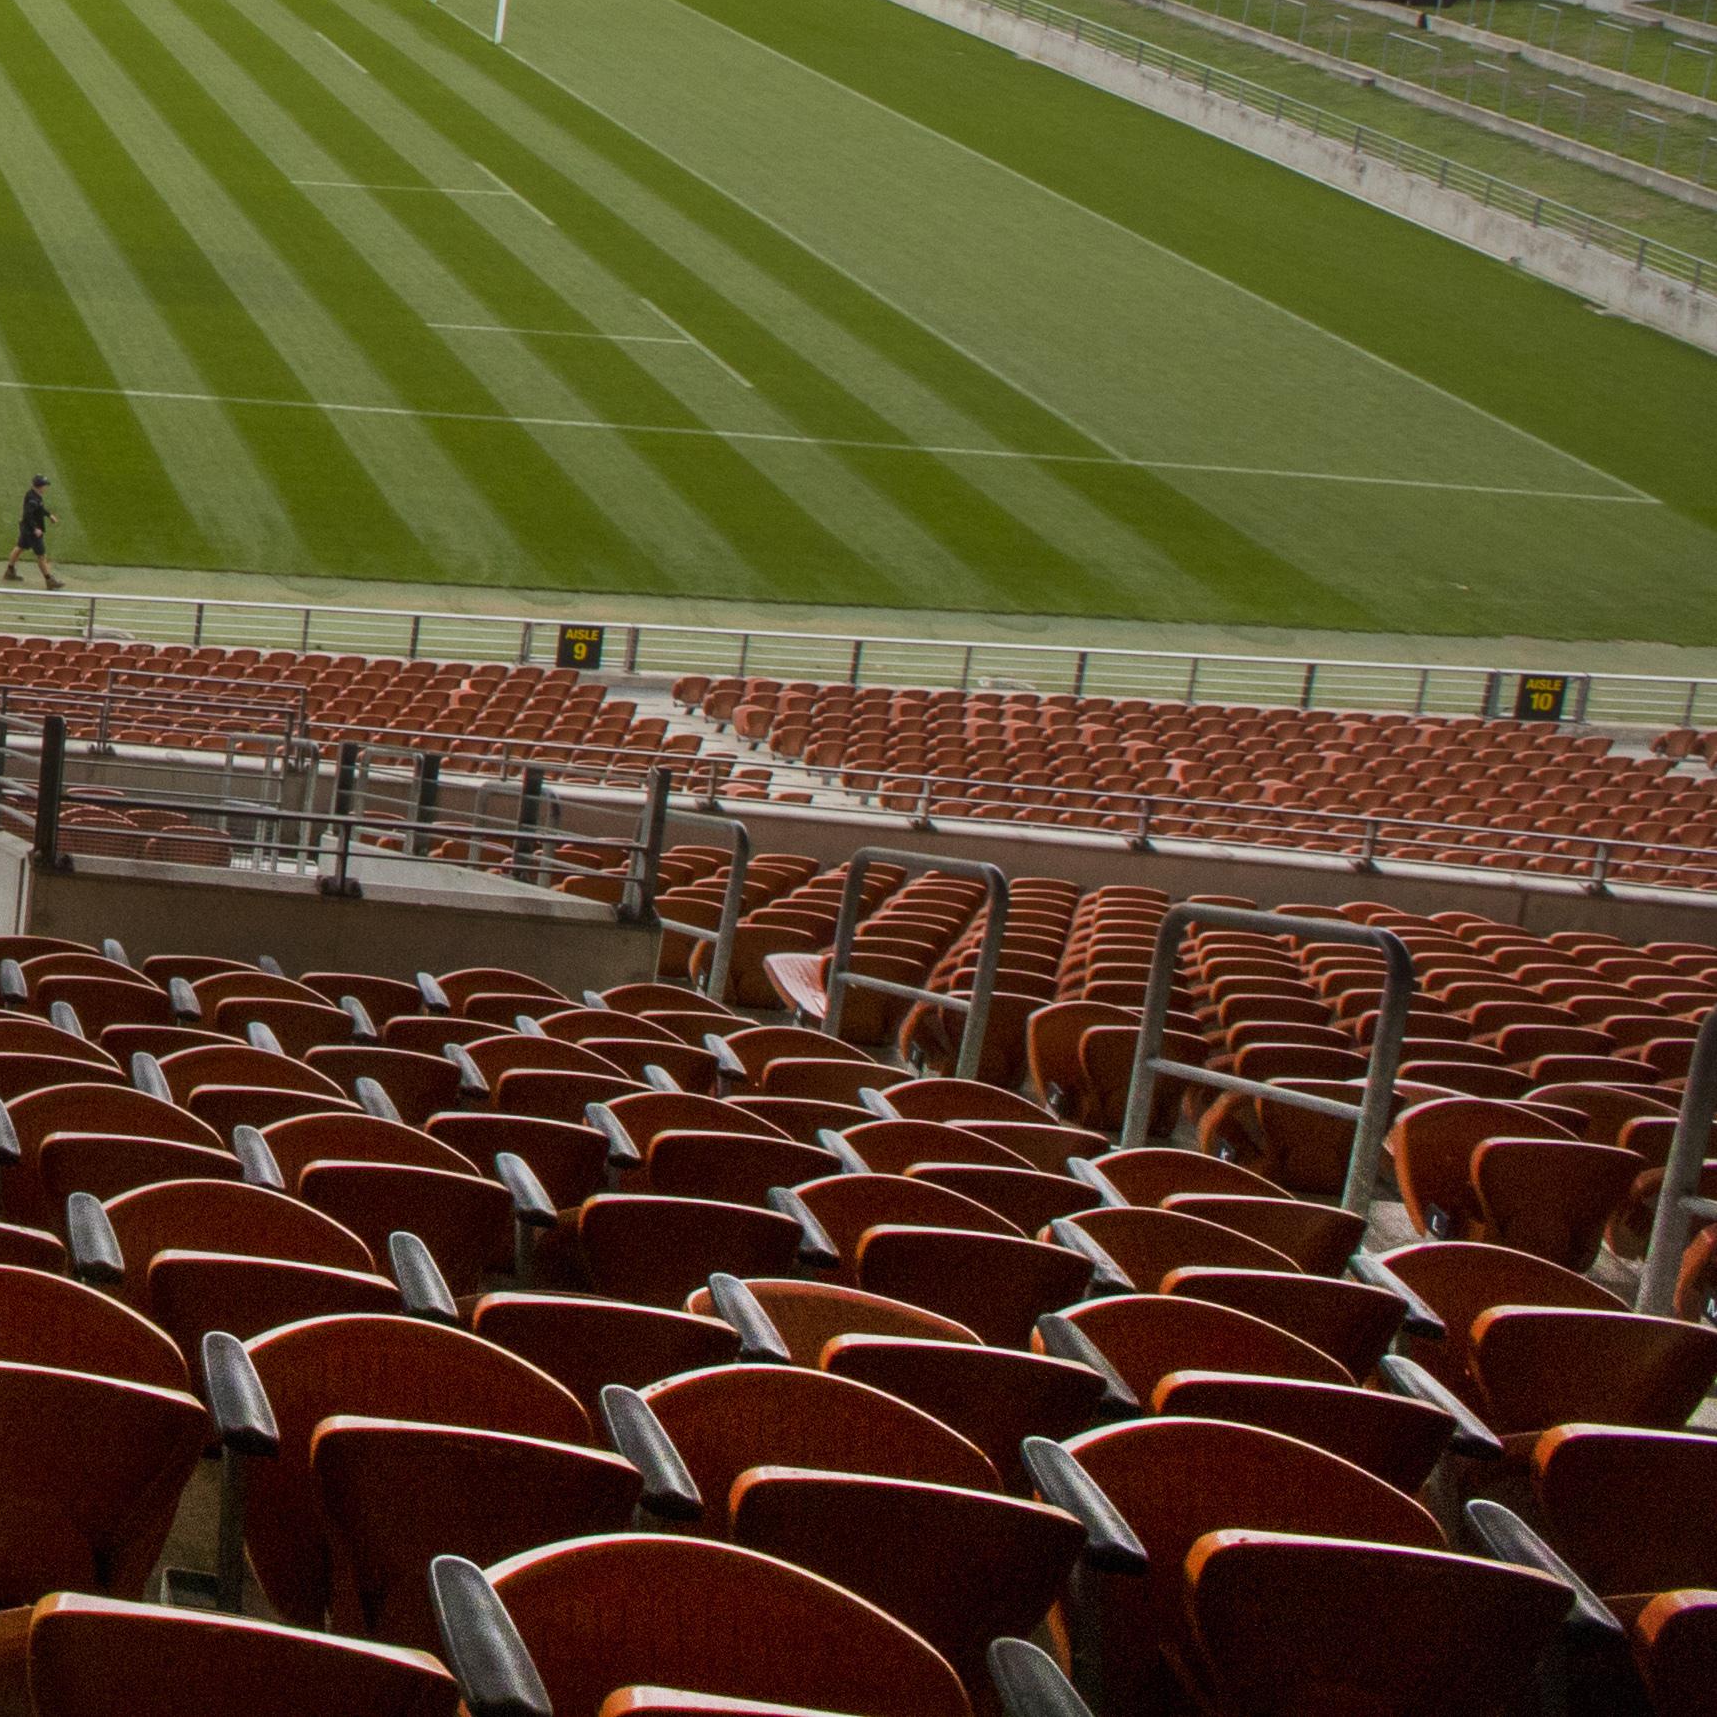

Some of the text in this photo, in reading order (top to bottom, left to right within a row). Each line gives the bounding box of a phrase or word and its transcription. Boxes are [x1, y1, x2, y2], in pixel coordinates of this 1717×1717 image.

[565, 628, 600, 641] AISLE
[573, 642, 587, 661] 9
[1526, 678, 1563, 691] AISLE
[1529, 693, 1552, 711] 10
